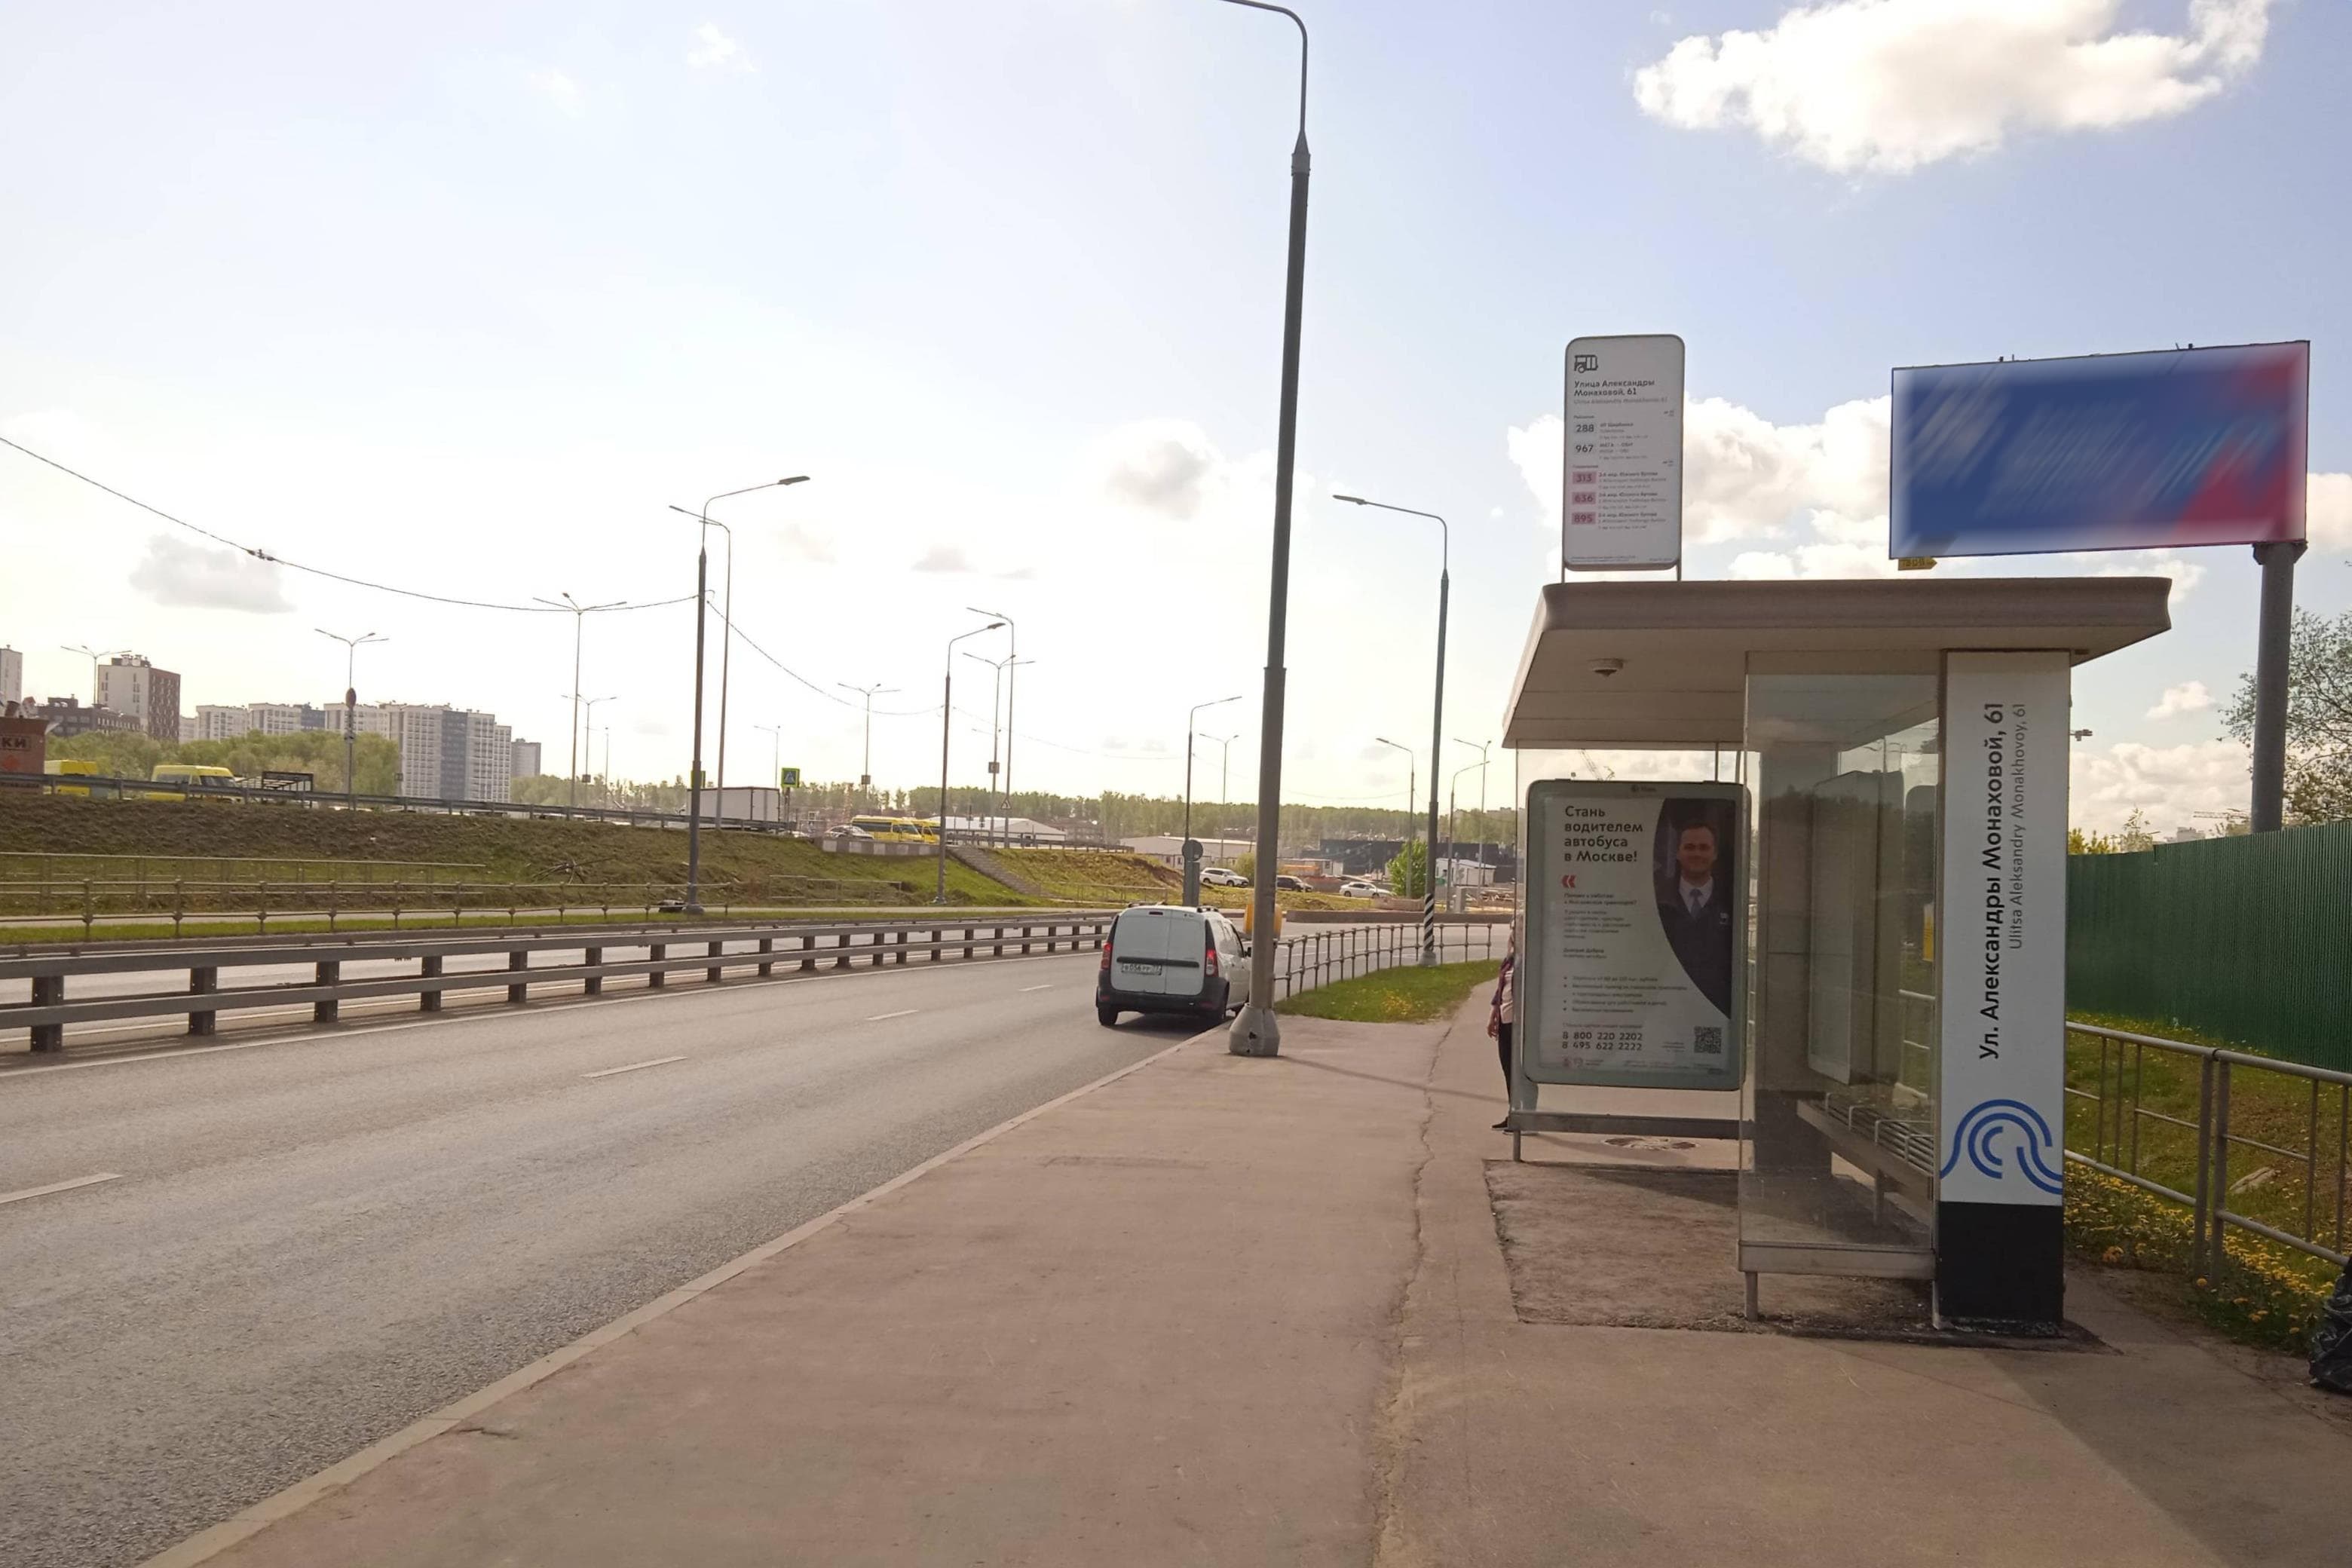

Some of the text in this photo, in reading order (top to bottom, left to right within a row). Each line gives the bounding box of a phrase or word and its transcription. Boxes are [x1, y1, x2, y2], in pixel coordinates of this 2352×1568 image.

[1574, 388, 1625, 397] Монаховой,
[1576, 424, 1594, 433] 288
[1575, 444, 1594, 453] 967
[1574, 514, 1593, 523] 895
[1565, 805, 1606, 817] Стань
[1564, 823, 1643, 833] водителем
[2008, 703, 2028, 949] Ulitsa Aleksandry Monakhovoy, 61
[1564, 835, 1628, 850] автобуса
[1564, 850, 1637, 862] в Москве!
[1979, 703, 2007, 1059] Ул. Александры Монаховой, 61
[1563, 1031, 1643, 1040] 8 800 220 2202
[1562, 1041, 1643, 1051] 8 495 622 2222
